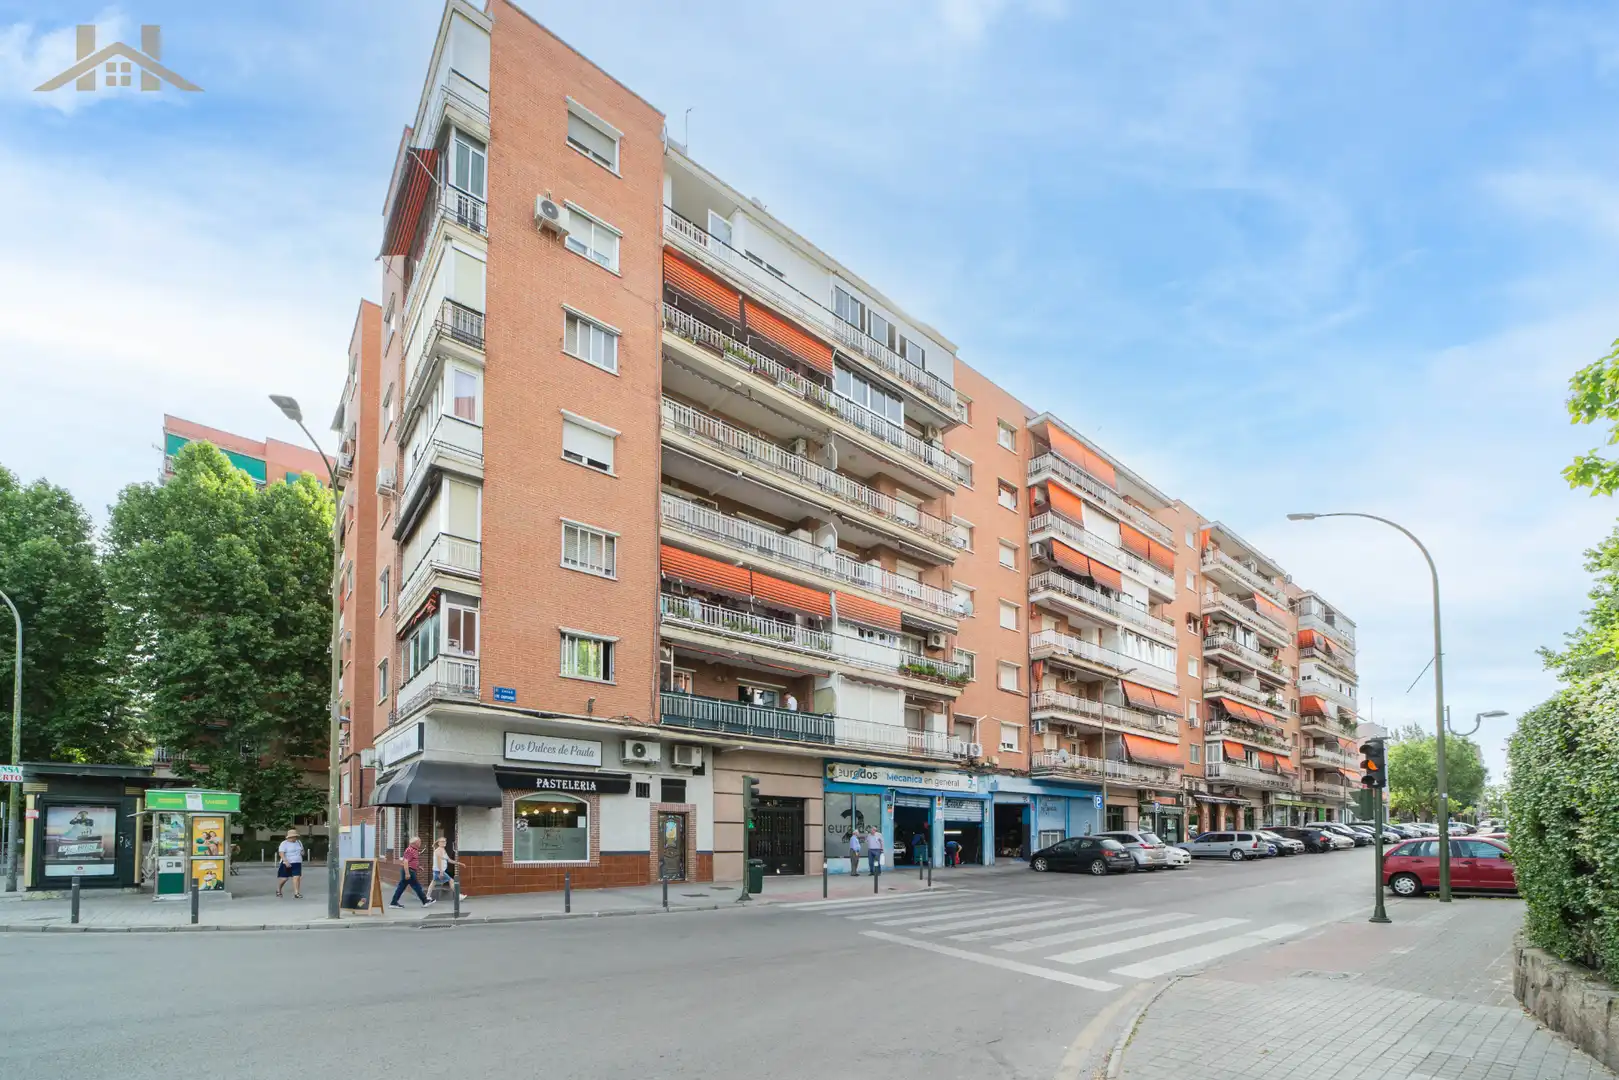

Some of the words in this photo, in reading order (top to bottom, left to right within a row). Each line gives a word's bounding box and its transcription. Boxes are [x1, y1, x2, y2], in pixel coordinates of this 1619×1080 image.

[509, 739, 525, 753] Los
[527, 740, 556, 754] Dulces
[558, 744, 569, 755] de
[570, 745, 595, 757] Paula
[536, 778, 597, 791] PASTELERIA
[924, 777, 933, 785] en
[935, 778, 960, 787] general
